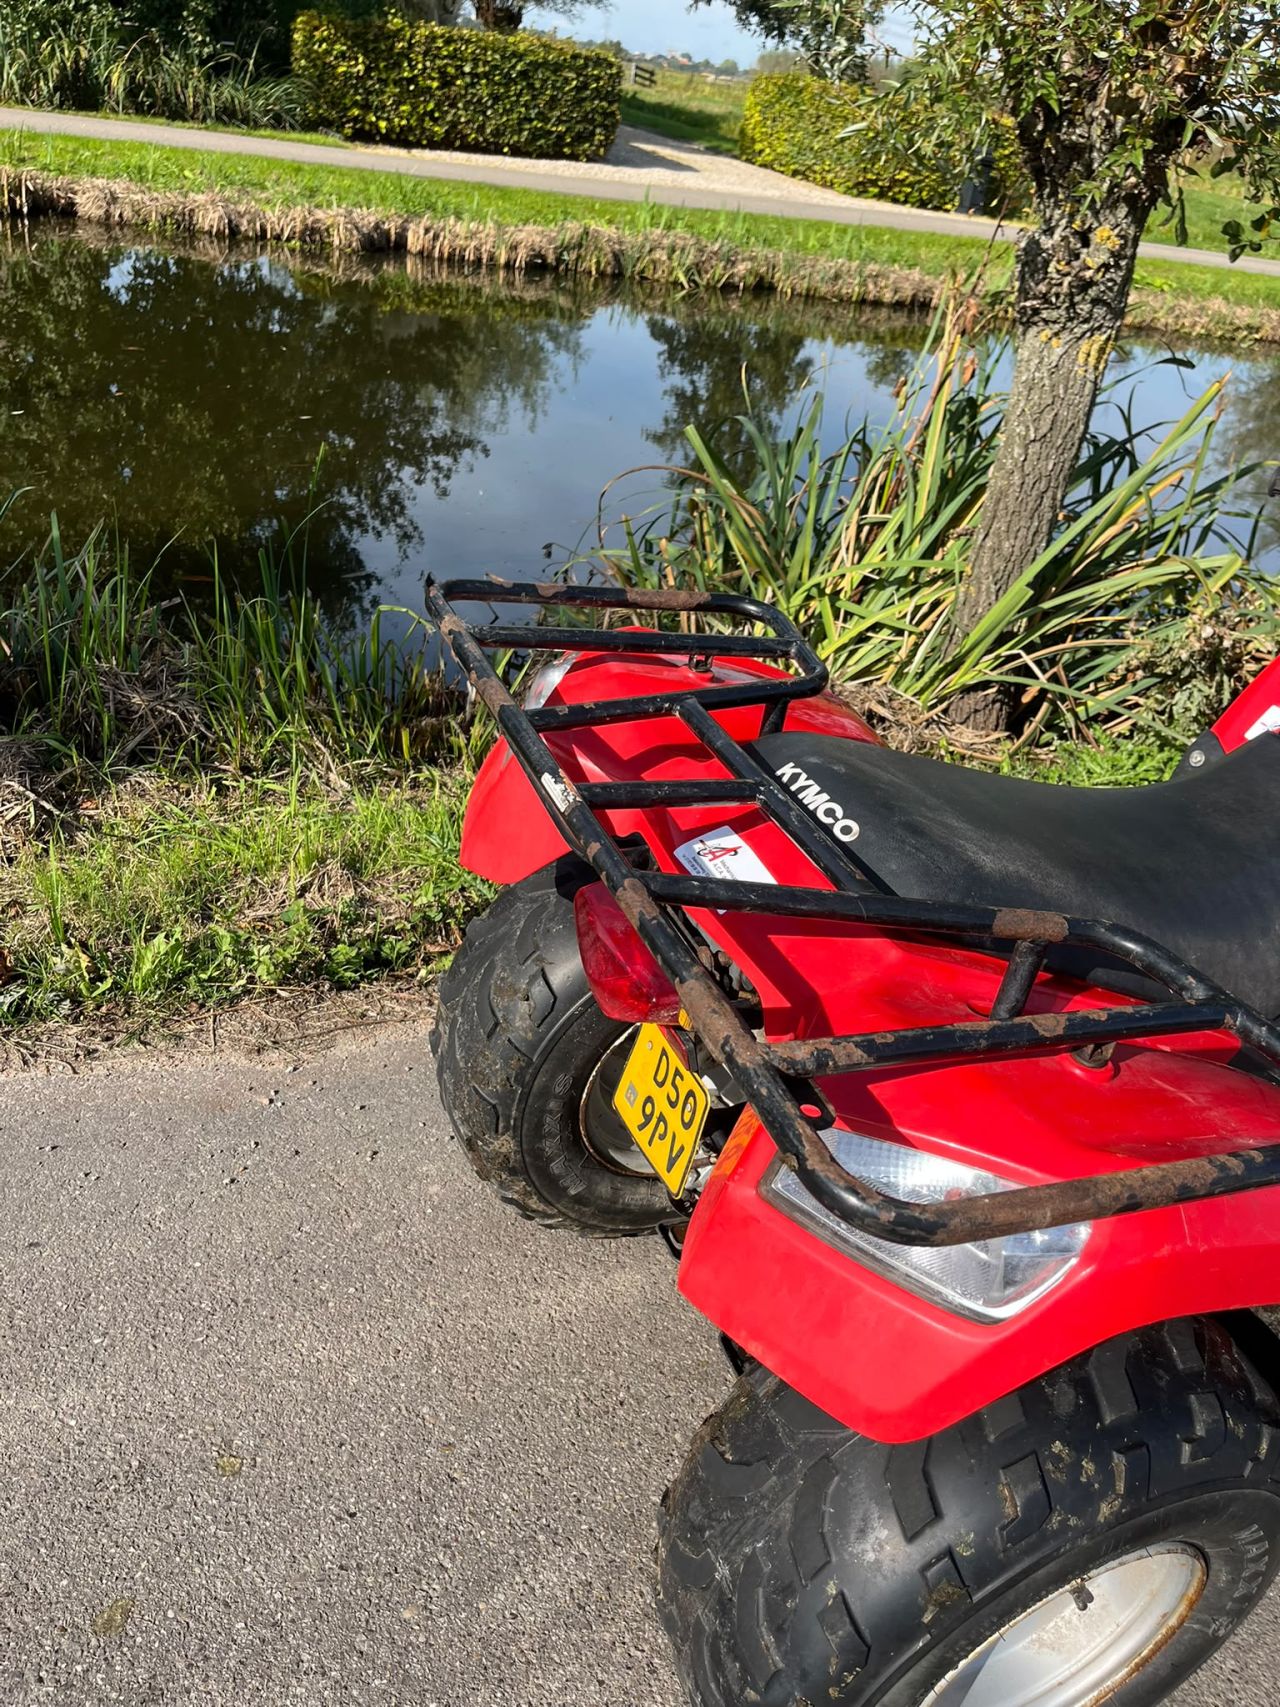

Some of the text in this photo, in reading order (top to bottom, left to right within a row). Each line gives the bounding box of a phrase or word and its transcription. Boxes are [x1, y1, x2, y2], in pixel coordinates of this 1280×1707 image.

[775, 761, 860, 842] KYMCO
[653, 1046, 697, 1131] D50
[542, 1073, 587, 1196] MAXXIS
[637, 1095, 685, 1174] 9PV
